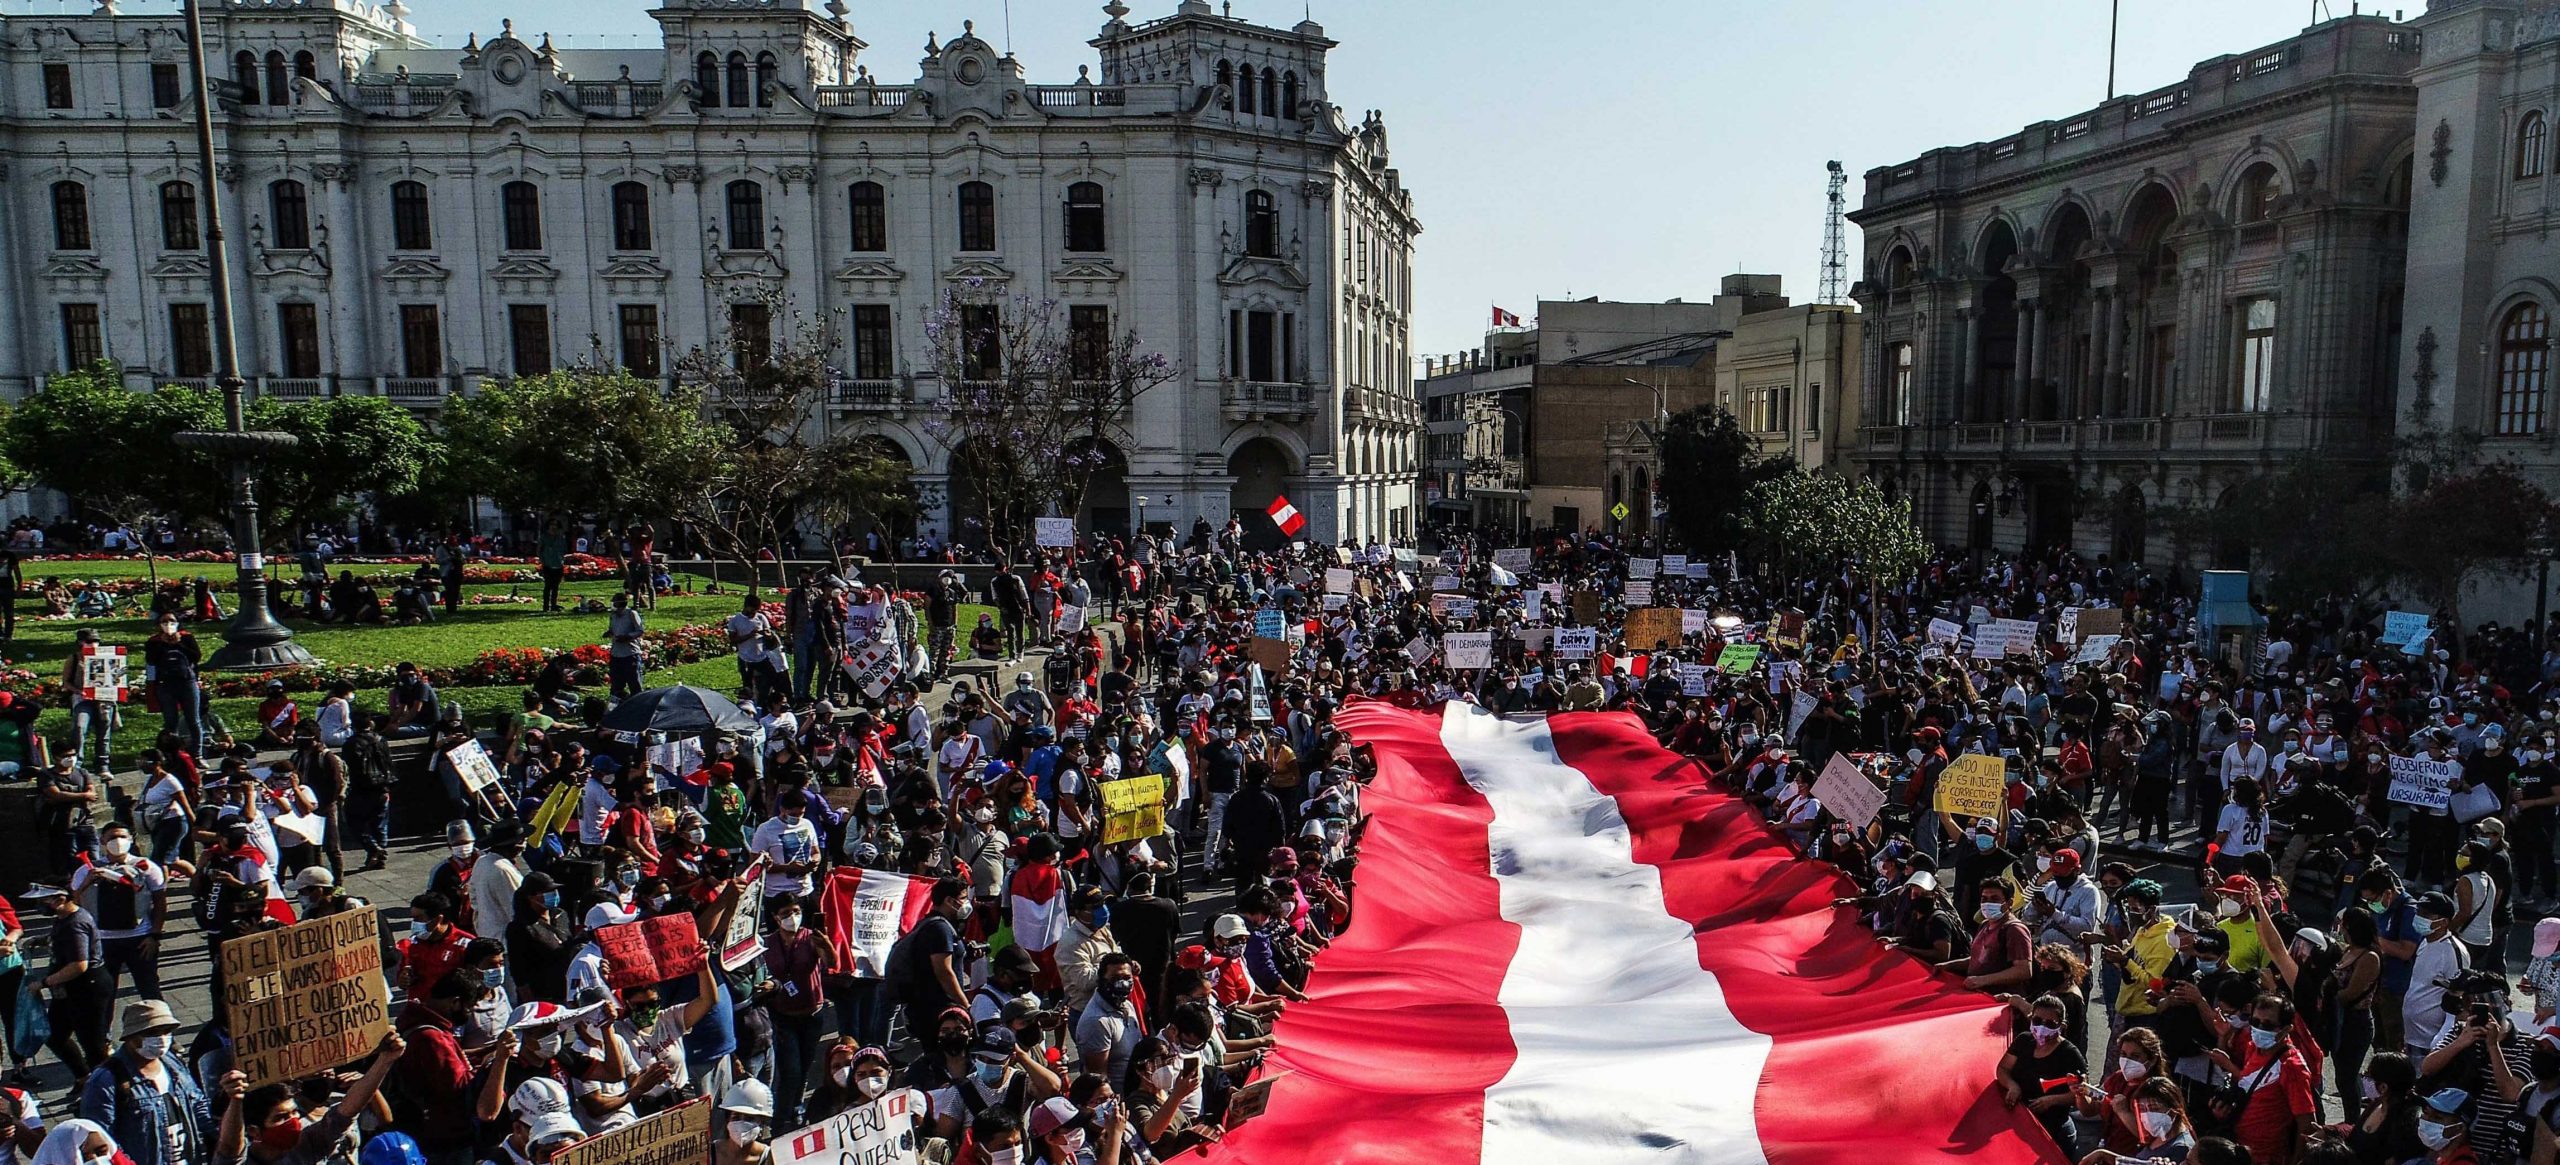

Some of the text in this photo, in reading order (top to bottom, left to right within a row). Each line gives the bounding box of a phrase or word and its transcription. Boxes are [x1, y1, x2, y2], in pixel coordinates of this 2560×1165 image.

[1560, 635, 1590, 645] ARMY
[1957, 774, 1967, 786] ES
[2391, 757, 2449, 776] GOBIERNO
[1950, 786, 1987, 799] CORRECTO
[1988, 791, 1998, 800] ES
[2243, 823, 2262, 846] 20
[206, 882, 222, 920] adidas
[251, 937, 278, 969] EL
[279, 920, 334, 962] PUEBLO
[335, 910, 377, 947] QUIERE
[226, 944, 381, 1006] QUE TE VAYAS CARADURA
[242, 1005, 253, 1033] Y
[283, 994, 302, 1022] TE
[310, 976, 367, 1014] QUEDAS
[235, 1000, 381, 1058] ENTONCES ESTAMOS
[244, 1056, 269, 1083] EN
[577, 1119, 664, 1165] INJUSTICIA
[670, 1111, 685, 1135] ES
